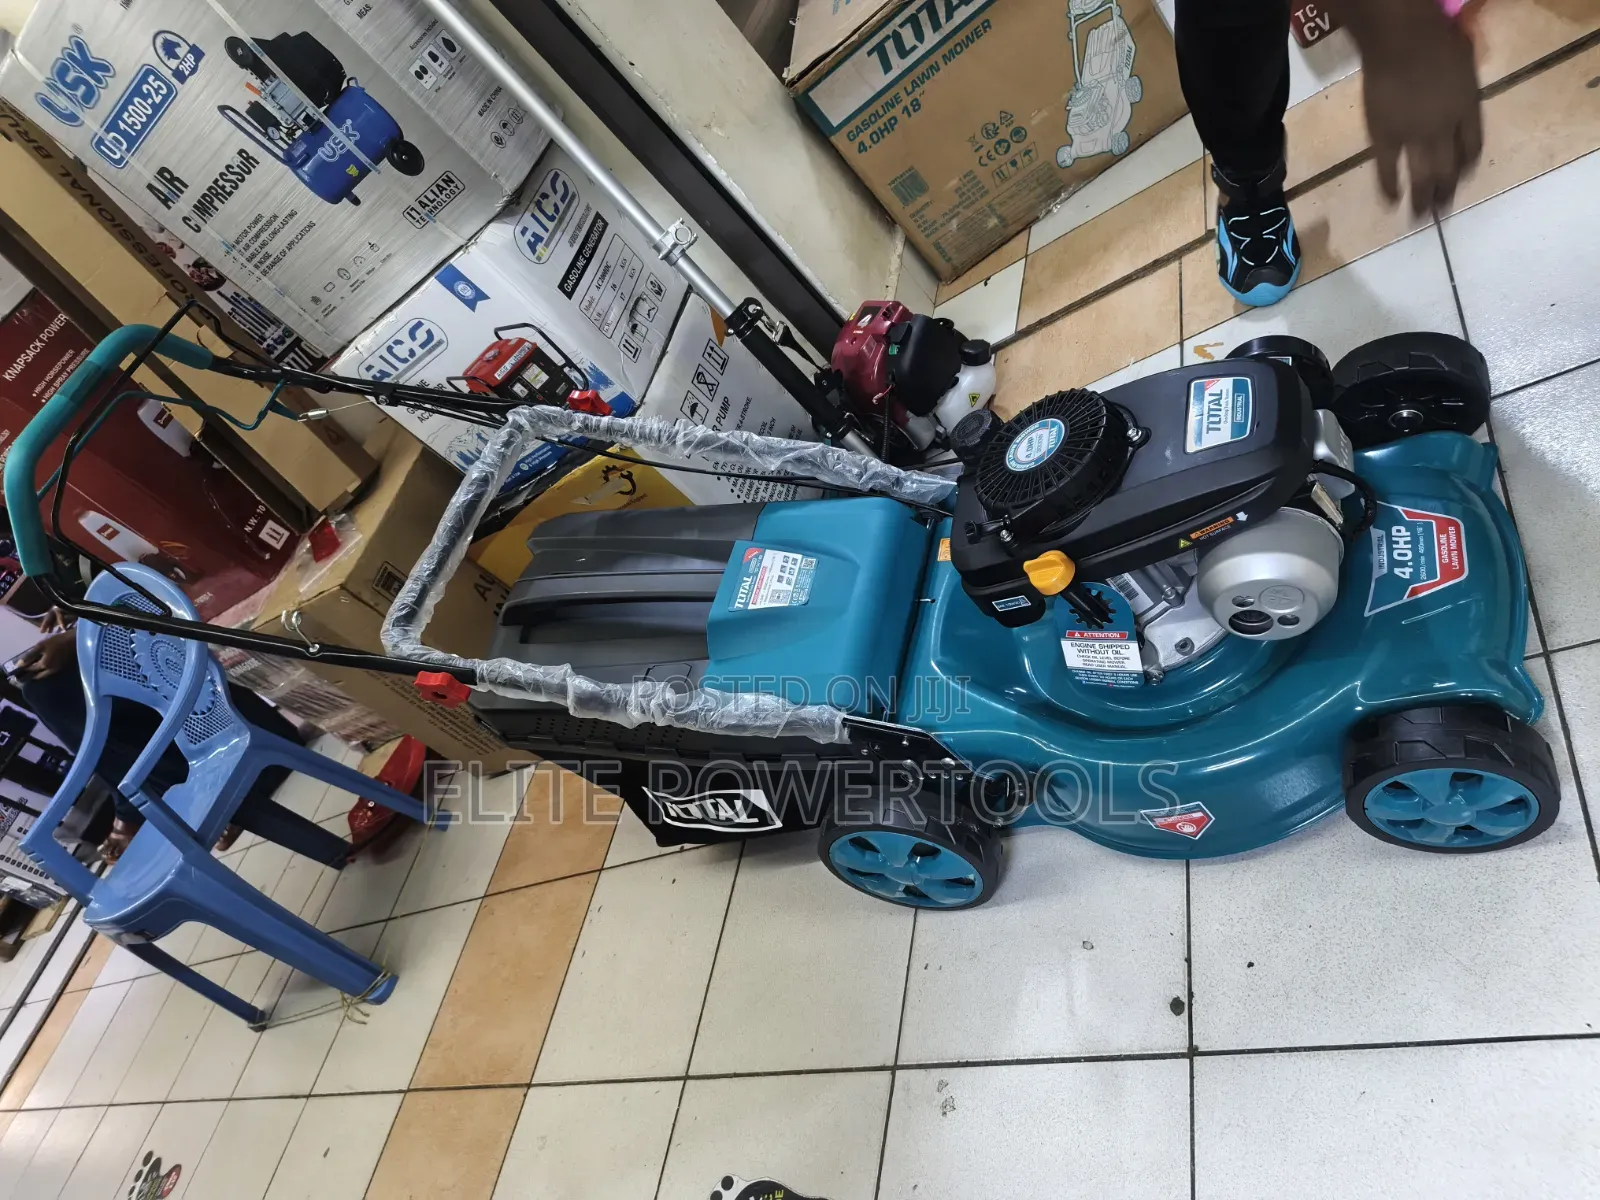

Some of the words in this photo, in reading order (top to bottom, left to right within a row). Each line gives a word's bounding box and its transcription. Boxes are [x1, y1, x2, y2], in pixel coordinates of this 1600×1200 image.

[356, 4, 374, 20] MEAS:
[1295, 3, 1318, 24] TC
[1302, 12, 1331, 42] CV
[35, 35, 116, 127] USK
[179, 53, 196, 77] 2HP
[846, 92, 903, 142] GASOLINE
[904, 58, 940, 95] LAWN
[942, 18, 993, 66] MOWER
[100, 132, 127, 161] UD
[119, 75, 168, 136] 1500-25
[476, 101, 491, 117] MADE
[857, 118, 899, 155] 4.0HP
[898, 89, 925, 121] 18"
[317, 124, 360, 162] USK
[146, 166, 189, 210] AIR
[415, 183, 461, 225] TEHNOLOGY
[232, 227, 251, 246] MOTOR
[245, 212, 265, 232] POWER
[246, 212, 280, 246] COMPRESSION
[256, 237, 270, 251] AND
[264, 207, 299, 242] LONG-LASTING
[525, 170, 571, 258] AICS
[241, 241, 252, 253] AIR
[256, 249, 273, 267] NOISE
[265, 253, 283, 272] RANGE
[278, 247, 289, 258] OF
[284, 219, 317, 252] APPLICATIONS
[561, 254, 588, 293] GASOLINE
[579, 217, 607, 258] GENERATOR
[608, 282, 618, 292] 16
[617, 291, 627, 301] 17
[3, 338, 45, 382] KNAPSACK
[39, 313, 69, 342] POWER
[365, 320, 436, 383] AICS
[34, 381, 46, 394] HIGH
[46, 349, 75, 383] HORSEPOWER
[43, 386, 55, 400] HIGH
[53, 371, 69, 388] SPRAY
[67, 348, 90, 372] PRESSURE
[715, 396, 732, 423] PUMP
[768, 416, 778, 430] INCH
[1205, 388, 1222, 434] TOTAL
[1198, 518, 1231, 535] WARNING
[1209, 524, 1232, 536] SURFACE
[1448, 526, 1457, 549] MOWER
[1376, 534, 1385, 569] INDUSTRIAL
[1390, 524, 1414, 579] 4.0HP
[1439, 533, 1448, 563] GASOLINE
[1450, 550, 1459, 569] LAWN
[734, 576, 753, 609] TOTAL
[1070, 642, 1097, 650] ENGINE
